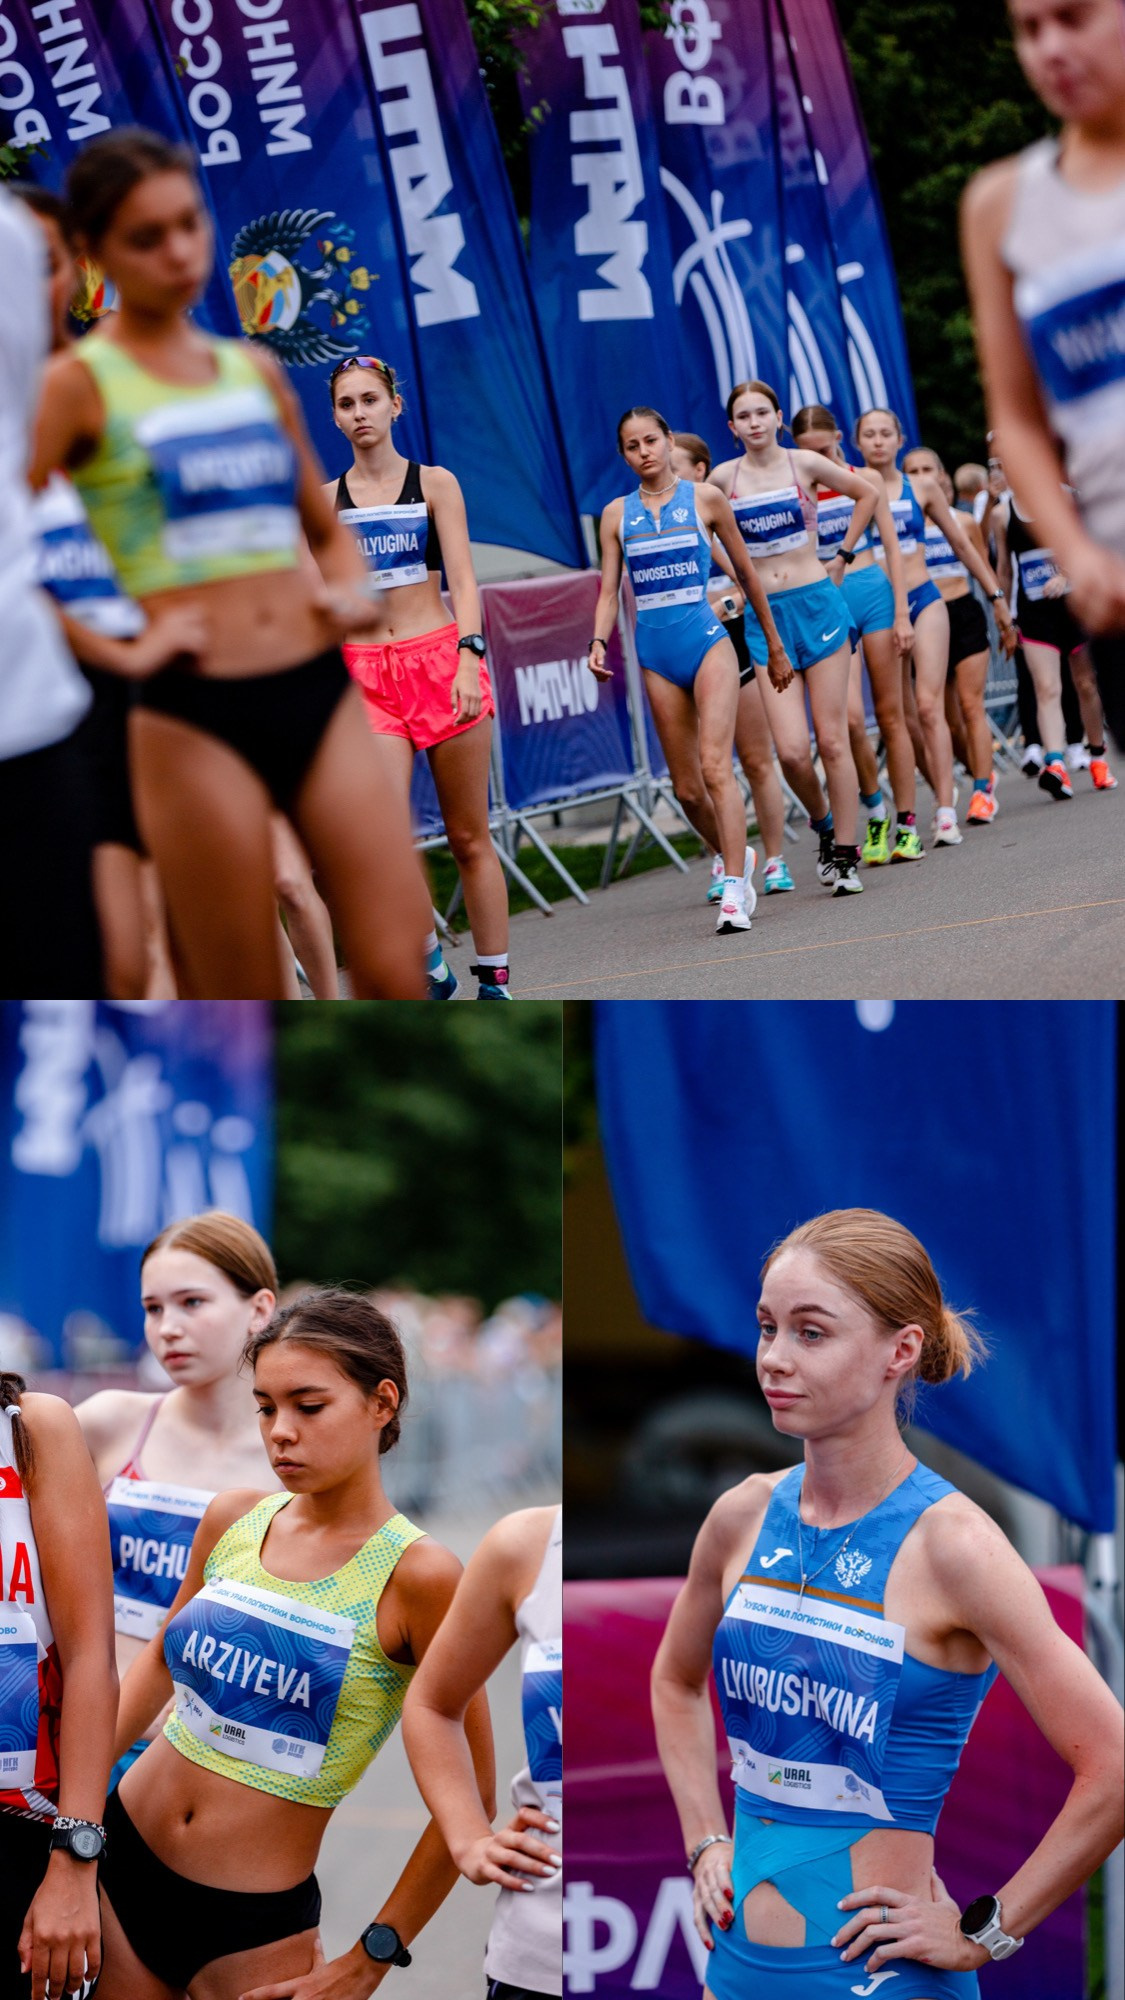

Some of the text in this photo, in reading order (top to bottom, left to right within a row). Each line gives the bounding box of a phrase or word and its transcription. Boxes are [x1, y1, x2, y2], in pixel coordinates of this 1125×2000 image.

[740, 510, 796, 533] PICHUGINA
[632, 560, 700, 584] NOVOSELTSEVA
[247, 1596, 288, 1619] ЛОГИСТИКИ
[289, 1613, 336, 1635] ВОРОНОВО
[769, 1604, 790, 1619] УРАЛ
[790, 1611, 843, 1632] ЛОГИСТИКИ
[844, 1626, 895, 1649] ВОРОНОВО
[182, 1630, 310, 1708] ARZIYEVA
[722, 1657, 879, 1744] LYUBUSHKINA
[224, 1723, 246, 1740] URAL
[784, 1767, 812, 1782] URAL
